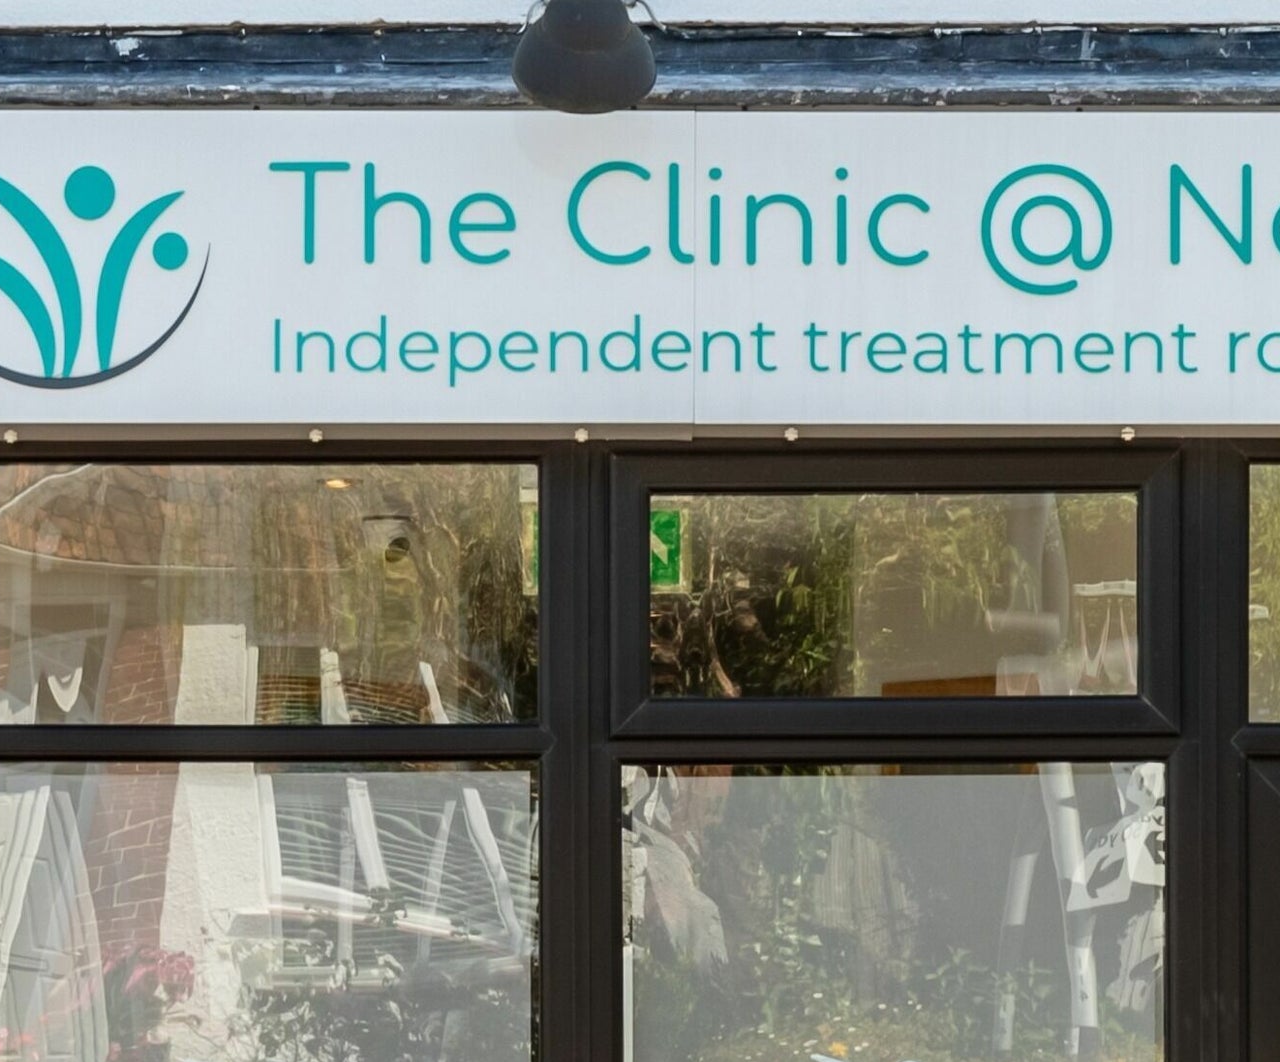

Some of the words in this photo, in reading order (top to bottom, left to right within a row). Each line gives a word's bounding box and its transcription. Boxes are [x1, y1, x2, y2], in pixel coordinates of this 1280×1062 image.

[269, 161, 516, 265] The
[567, 161, 930, 266] Clinic
[981, 164, 1113, 296] @
[273, 315, 777, 387] Independent
[804, 322, 1198, 374] treatment
